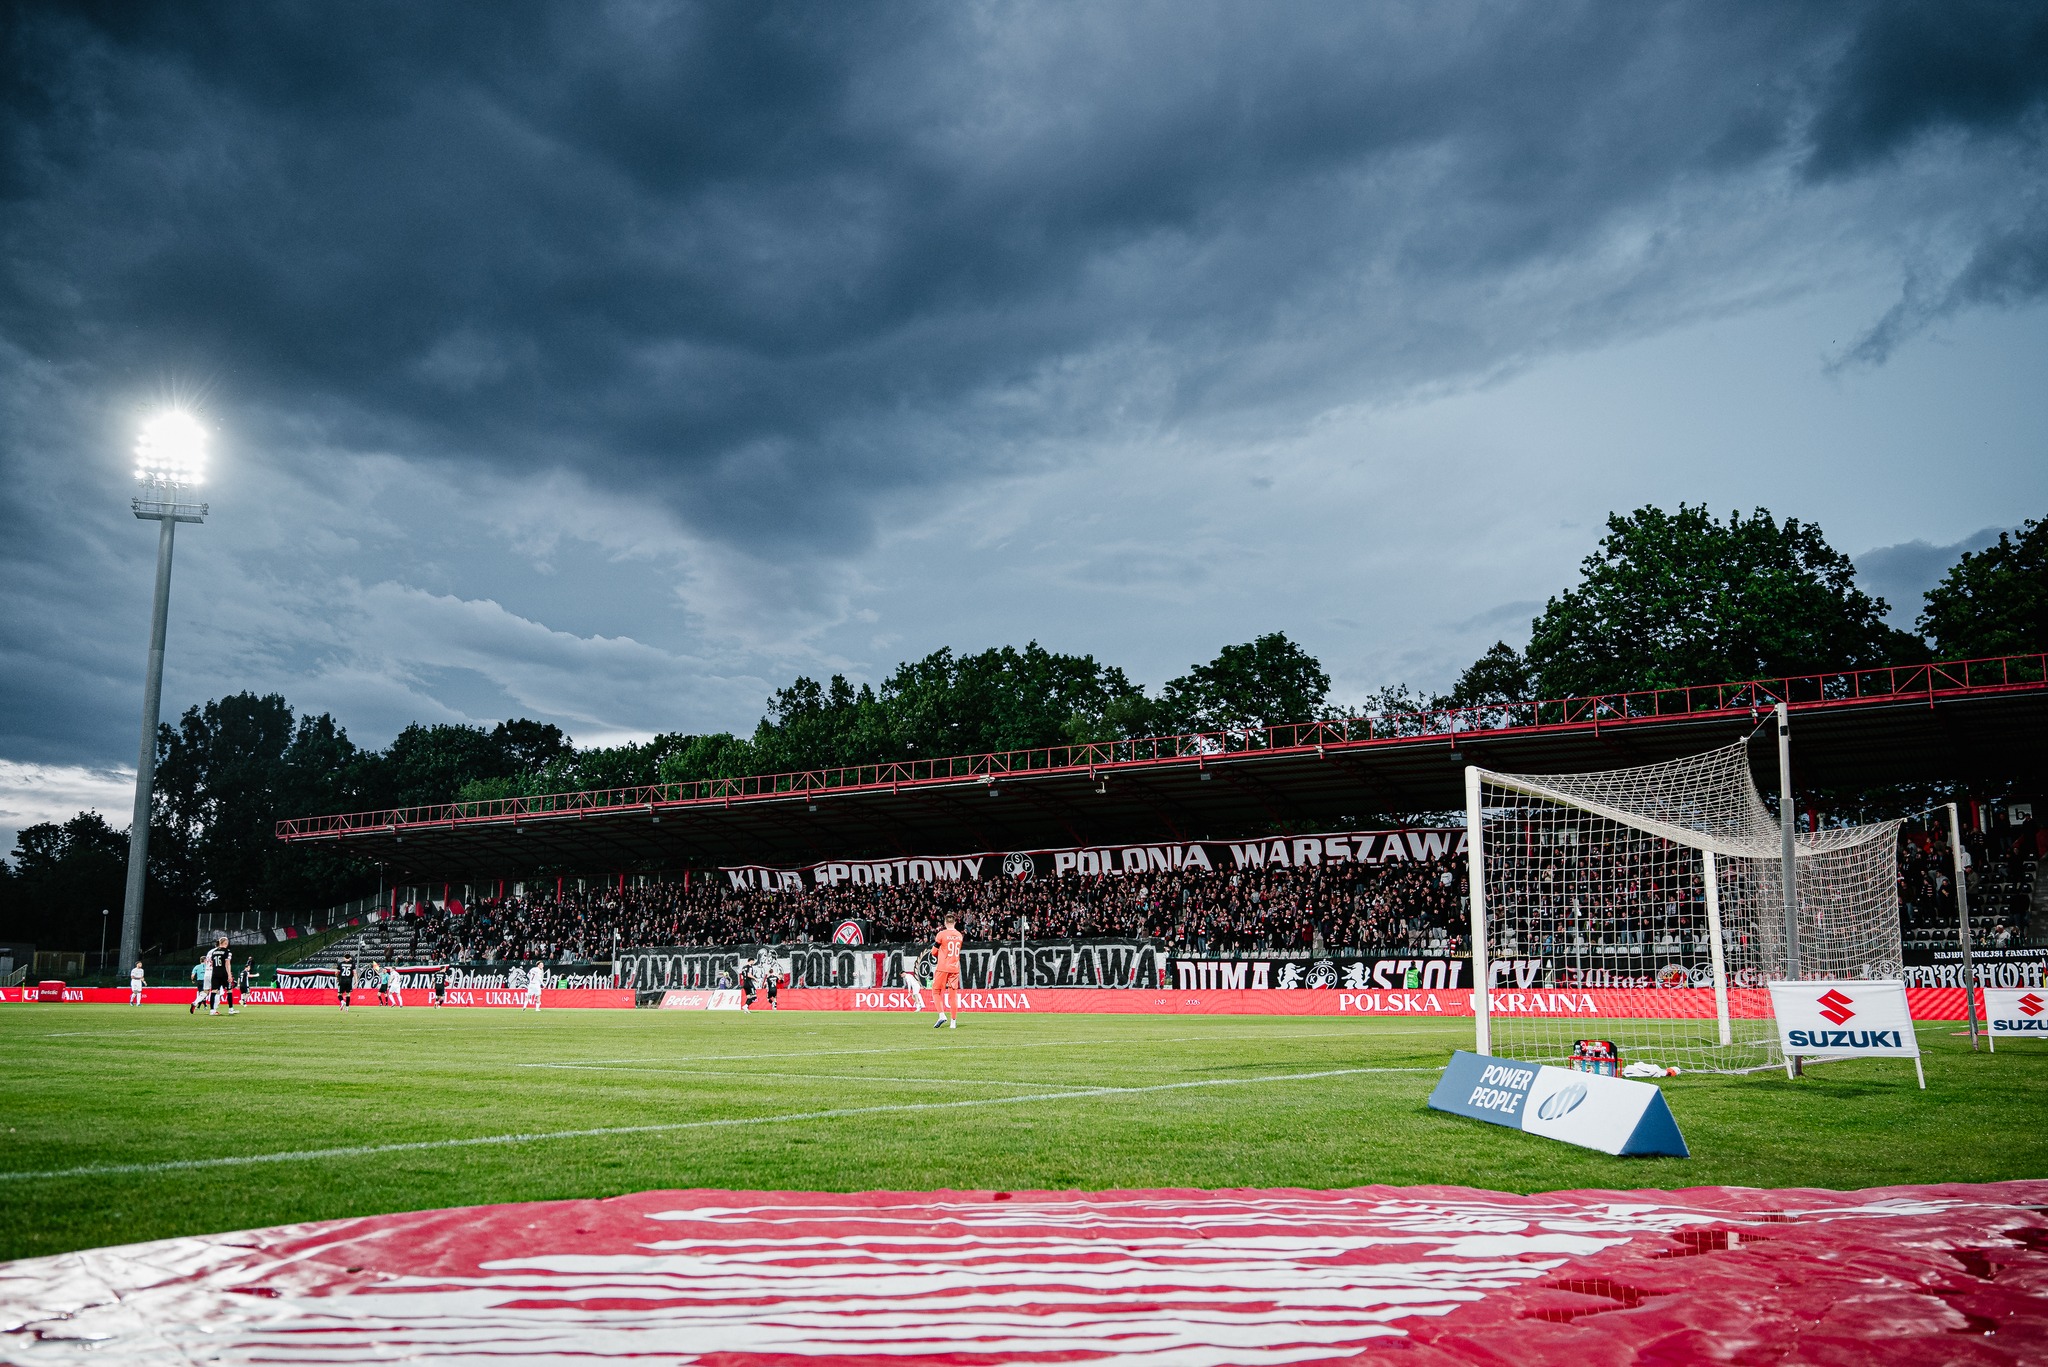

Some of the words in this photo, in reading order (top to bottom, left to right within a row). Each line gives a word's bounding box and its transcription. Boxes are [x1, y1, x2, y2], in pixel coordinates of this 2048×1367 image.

[1055, 845, 1213, 879] POLONIA
[815, 857, 984, 888] SPORTOWY
[947, 941, 961, 957] 96
[1934, 950, 2003, 959] NAJWIRNIEJSI
[213, 955, 222, 966] 16
[619, 953, 740, 990] FANATICS
[789, 950, 907, 989] POLONIA
[957, 944, 1160, 989] WARSZAWA
[342, 967, 351, 976] 26
[531, 973, 536, 981] 7
[1176, 962, 1270, 989] DUMA
[1373, 960, 1541, 989] STOLCY
[428, 992, 474, 1004] PLSKA
[665, 994, 702, 1006] Betclic
[855, 993, 926, 1008] POLSKA
[944, 993, 1030, 1008] UKRAINA
[1339, 993, 1443, 1011] POLSKA
[1788, 1030, 1903, 1048] SUZUKI
[1480, 1064, 1534, 1091] POWER
[1468, 1086, 1523, 1114] PEOPLE
